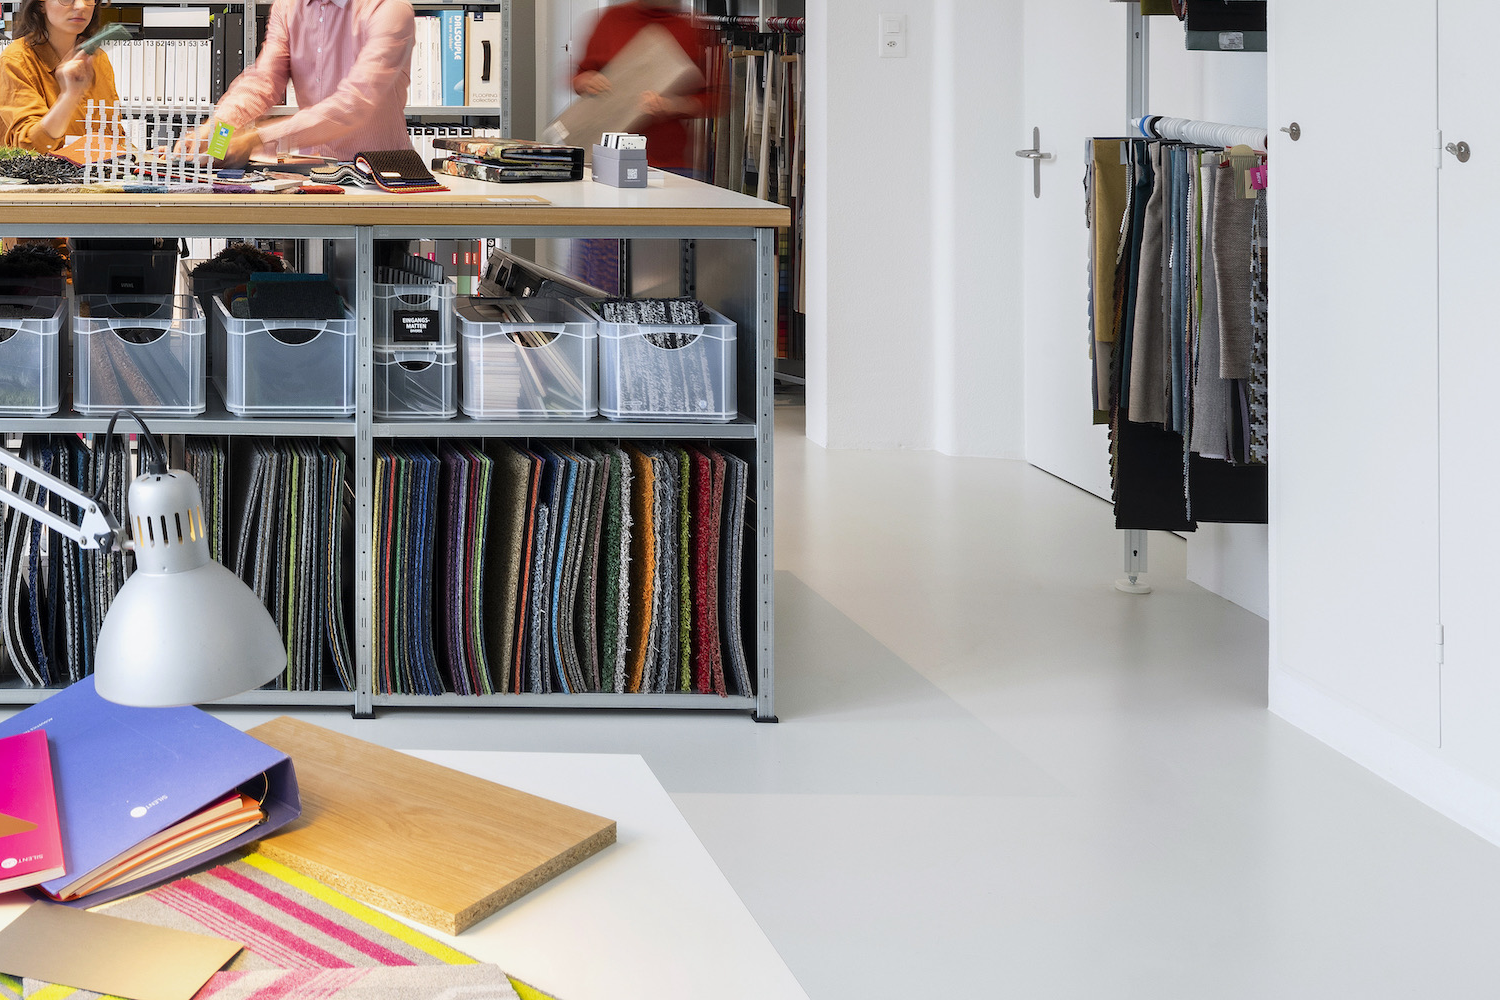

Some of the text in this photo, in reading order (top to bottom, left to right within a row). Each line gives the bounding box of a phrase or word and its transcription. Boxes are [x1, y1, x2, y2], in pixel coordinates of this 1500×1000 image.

[454, 15, 462, 60] DALSOUPLE
[146, 794, 168, 810] SILENT
[18, 854, 43, 864] SILENT
